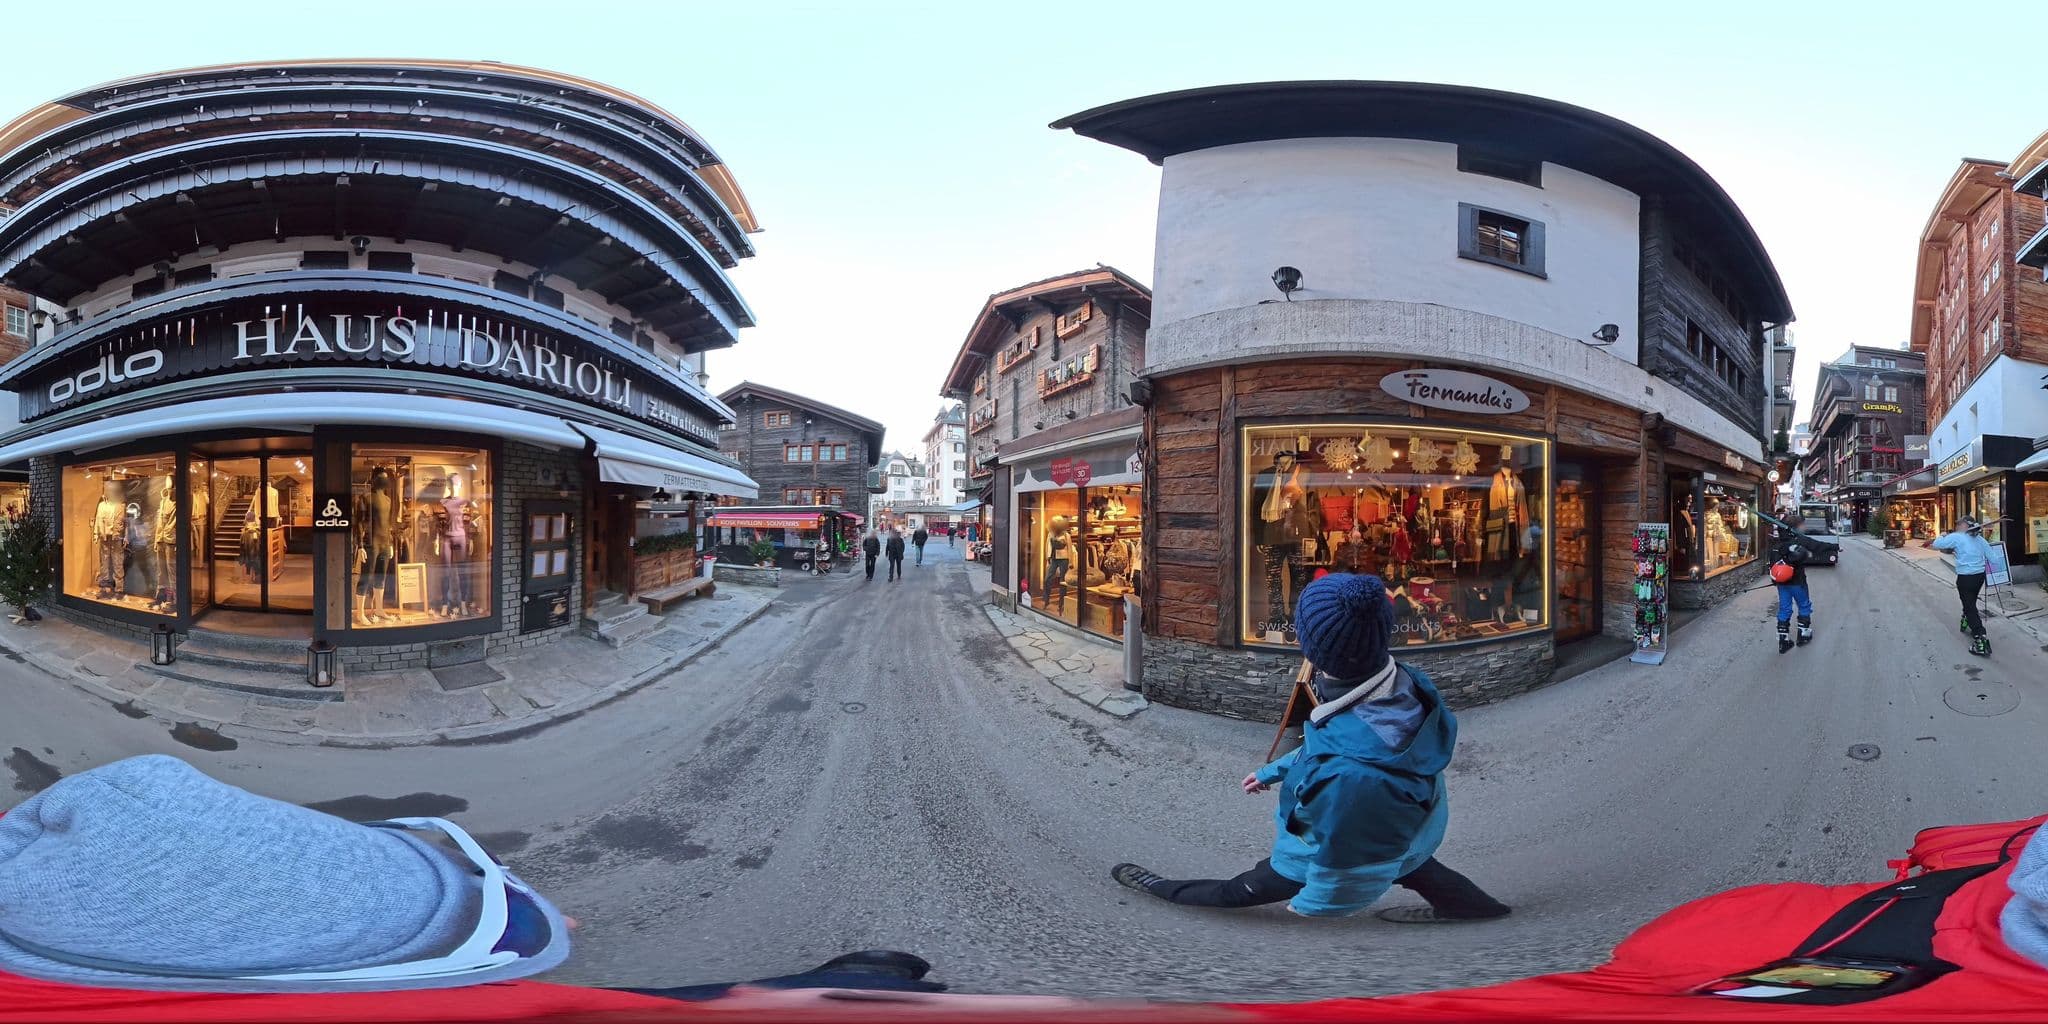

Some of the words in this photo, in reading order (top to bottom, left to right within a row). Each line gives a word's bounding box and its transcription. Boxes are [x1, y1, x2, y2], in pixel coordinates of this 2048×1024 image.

[49, 348, 164, 403] odlo
[233, 312, 417, 360] HAUS
[460, 328, 632, 409] DARIOLI
[1404, 373, 1513, 410] Fernanda's
[315, 518, 349, 528] odlo
[1258, 618, 1296, 634] swiss
[1391, 619, 1441, 635] oducts
